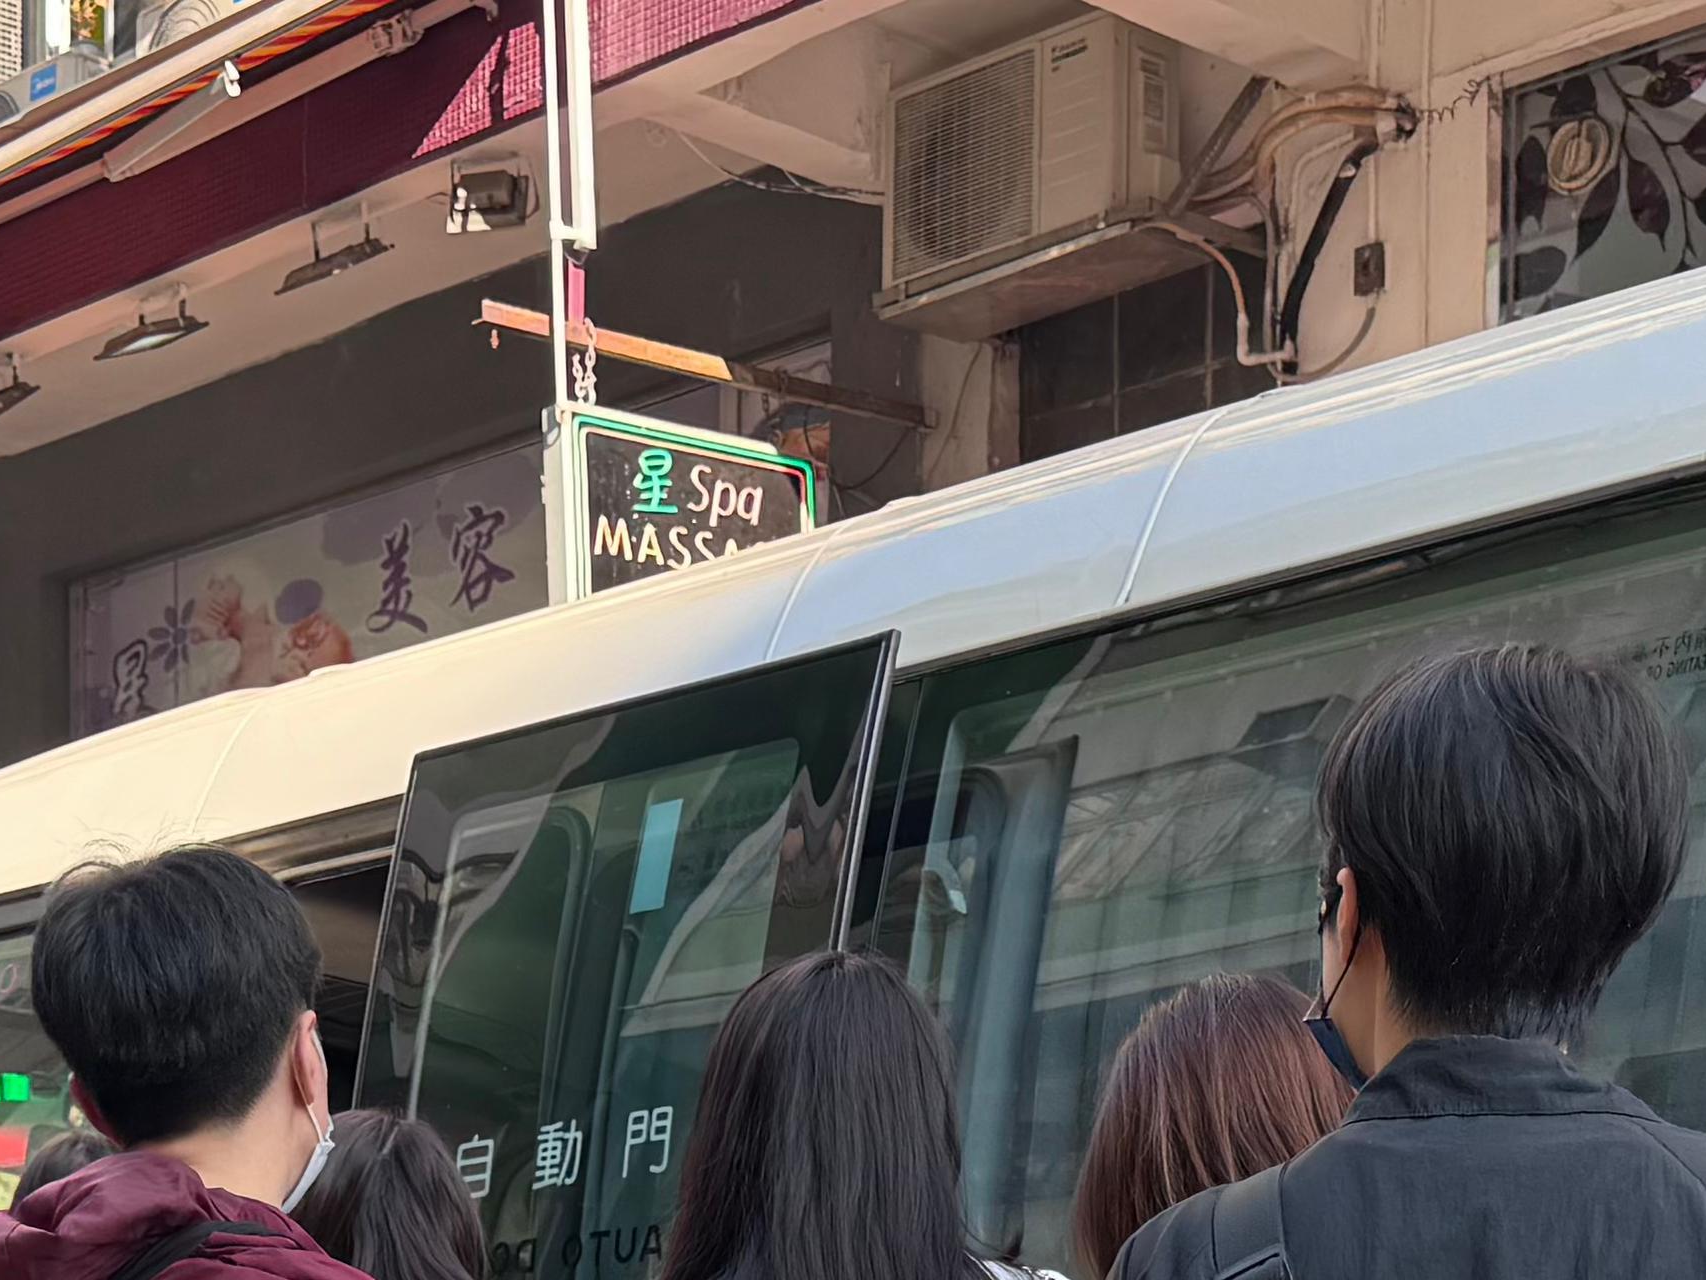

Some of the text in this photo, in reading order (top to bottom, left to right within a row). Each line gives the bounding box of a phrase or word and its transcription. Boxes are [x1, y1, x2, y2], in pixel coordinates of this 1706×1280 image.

[632, 449, 764, 528] 星 Spa
[366, 503, 515, 634] 美容
[455, 1106, 674, 1199] 自動門
